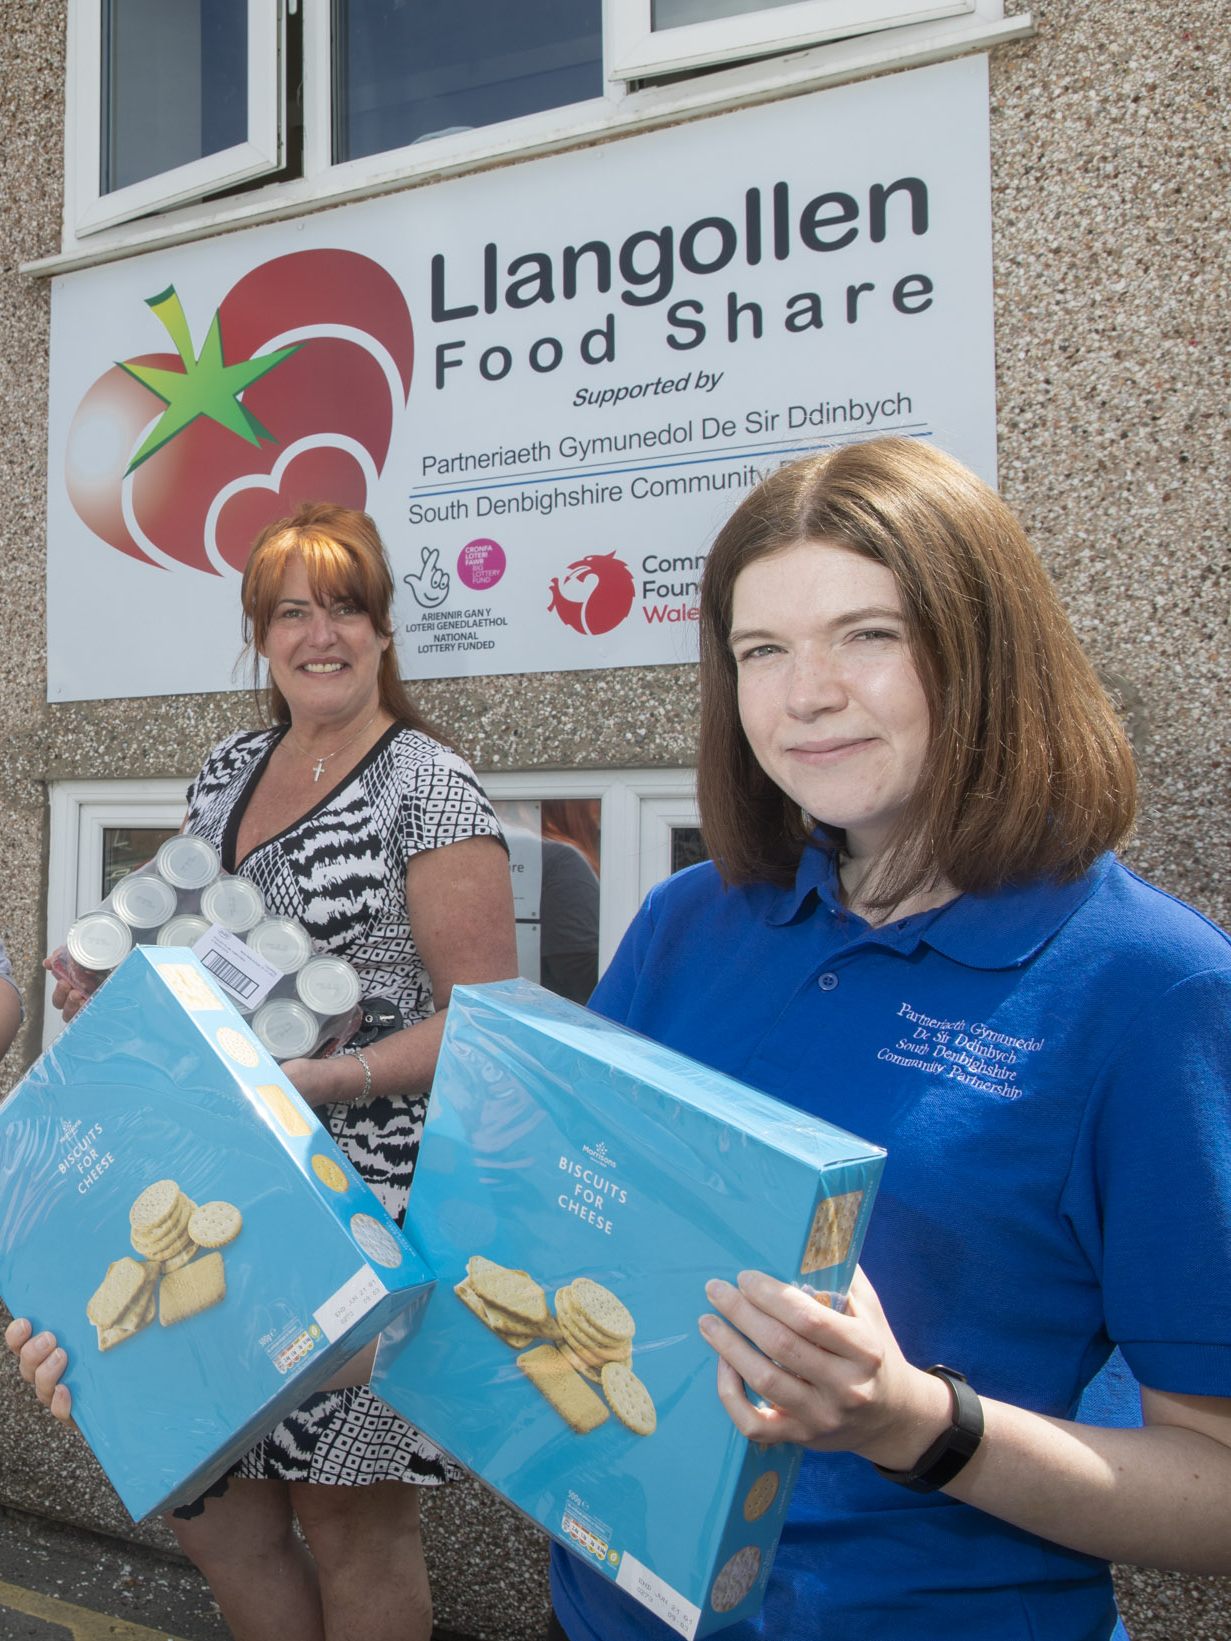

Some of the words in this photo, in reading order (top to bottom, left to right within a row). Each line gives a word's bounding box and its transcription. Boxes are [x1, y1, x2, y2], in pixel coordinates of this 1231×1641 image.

[431, 176, 928, 323] Llangollen
[435, 313, 616, 390] Food
[666, 273, 934, 351] Share
[572, 372, 692, 408] Supported
[694, 370, 724, 393] by
[422, 441, 551, 476] Partneriaeth
[559, 420, 693, 461] Gymunedol
[702, 417, 737, 440] De
[745, 410, 780, 433] Sir
[788, 392, 912, 429] Ddinbych
[408, 499, 469, 524] South
[476, 479, 623, 516] Denbighshire
[465, 545, 493, 553] CRONFA
[465, 552, 488, 560] LOTERI
[472, 570, 500, 578] LOTTERY
[406, 623, 434, 633] LOTERI
[436, 617, 508, 630] GENEDLAETHOL
[421, 611, 462, 622] ARIENNIR
[464, 609, 484, 618] GAN
[485, 608, 492, 617] Y
[642, 603, 700, 624] Wale
[418, 643, 456, 654] LOTTERY
[458, 640, 496, 651] FUNDED
[434, 632, 479, 643] NATIONAL
[896, 1002, 966, 1031] Partneriaeth
[970, 1022, 1046, 1052] Gymunedol
[913, 1027, 931, 1040] De
[933, 1030, 952, 1044] Sir
[954, 1033, 1017, 1064] Ddinbych
[877, 1048, 946, 1074] Community
[948, 1064, 1022, 1100] Partnership
[896, 1038, 929, 1056] South
[932, 1045, 1018, 1082] Denbighshire
[58, 1122, 103, 1174] BISCUITS
[76, 1148, 99, 1174] FOR
[582, 1144, 617, 1168] Morrisons
[78, 1152, 115, 1194] CHEESE
[558, 1156, 628, 1204] BISCUITS
[558, 1194, 613, 1235] CHEESE
[574, 1184, 603, 1210] FOR
